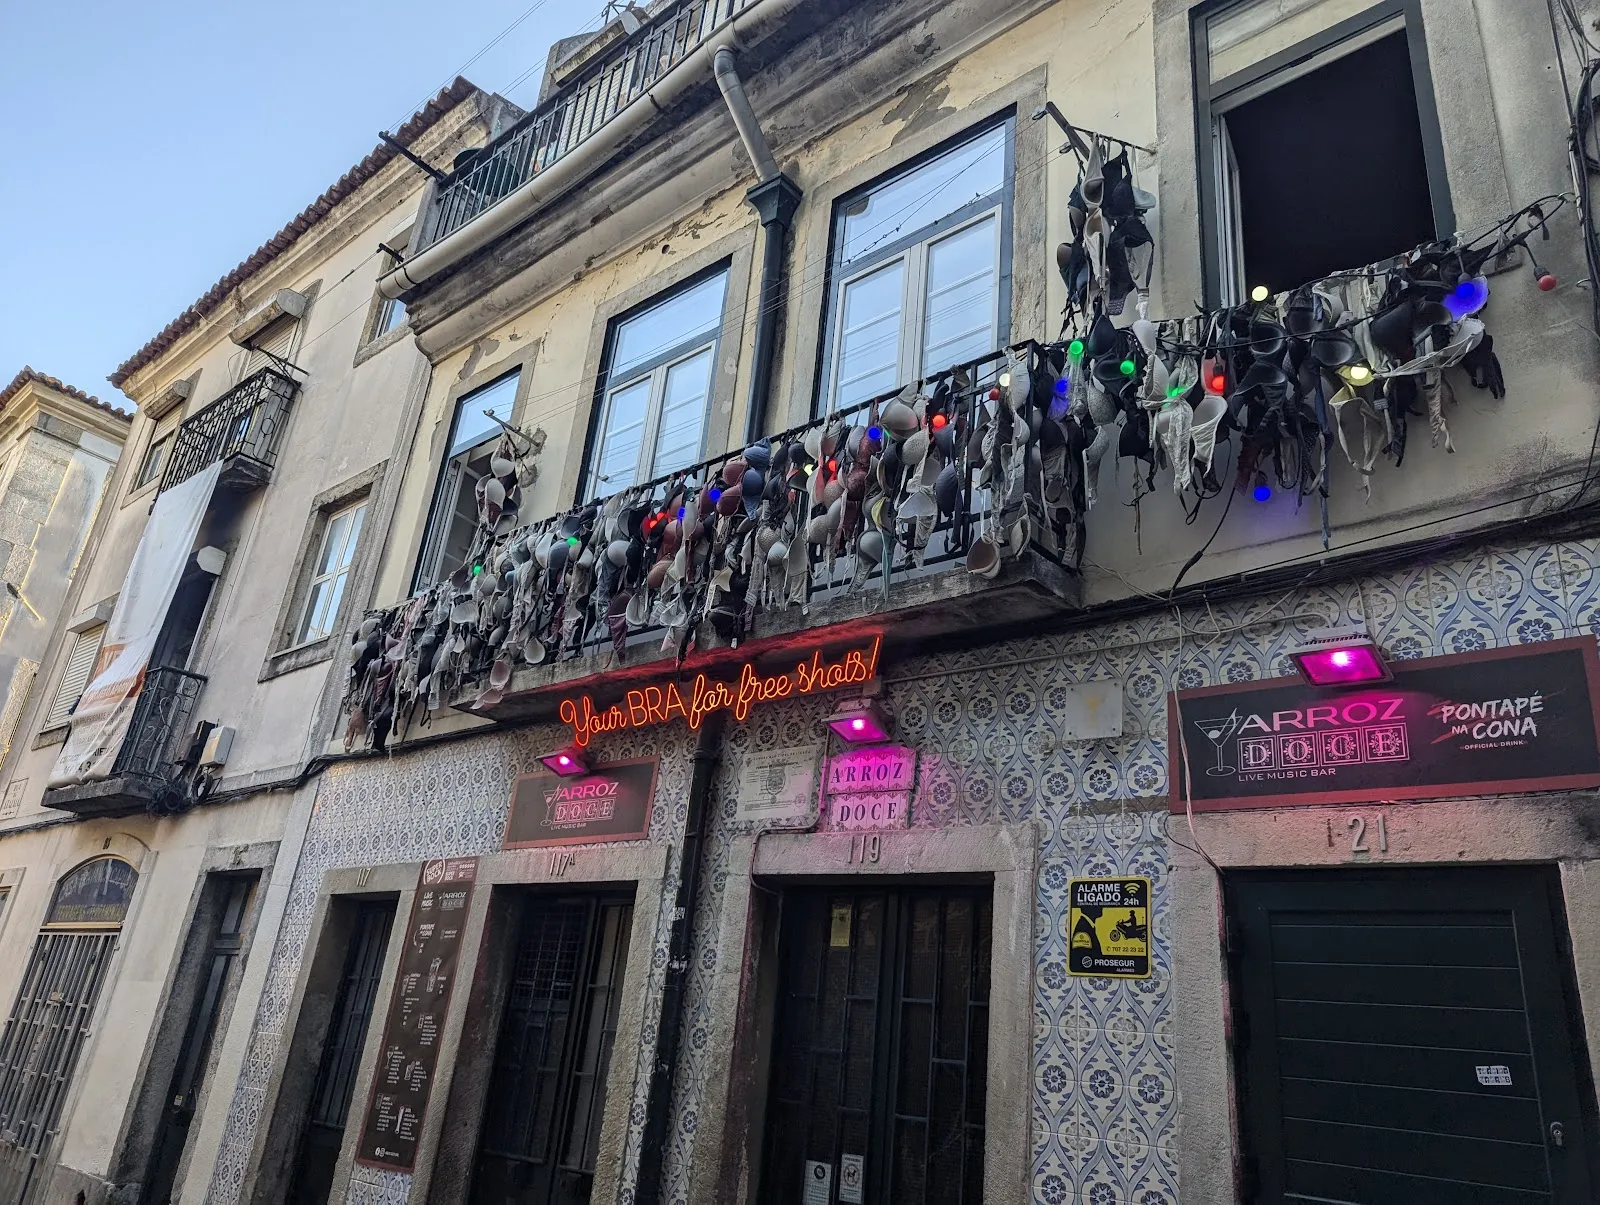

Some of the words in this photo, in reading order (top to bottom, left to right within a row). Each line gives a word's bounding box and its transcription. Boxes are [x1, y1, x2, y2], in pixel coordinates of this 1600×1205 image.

[560, 695, 627, 747] Your
[627, 683, 687, 726] BRA
[690, 674, 734, 730] for
[736, 664, 793, 721] free
[798, 636, 880, 692] shots!
[1237, 698, 1406, 735] ARROZ
[1441, 690, 1544, 724] PONTAPÉ
[1452, 724, 1469, 735] NA
[1472, 716, 1538, 740] CONA
[1246, 730, 1399, 766] DOCE
[1464, 742, 1498, 750] OFFICIAL
[831, 762, 903, 784] ARROZ
[1238, 773, 1264, 782] LIVE
[1267, 770, 1308, 780] MUSIC
[1311, 768, 1337, 777] BAR
[556, 781, 619, 801] ARROZ
[556, 801, 612, 820] DOCE
[840, 802, 897, 822] DOCE
[848, 835, 880, 864] 119
[356, 867, 372, 887] 117
[1077, 883, 1121, 893] ALARME
[1077, 892, 1121, 902] LIGADO
[1123, 897, 1140, 906] 24h
[1094, 958, 1135, 967] PROSEGUR
